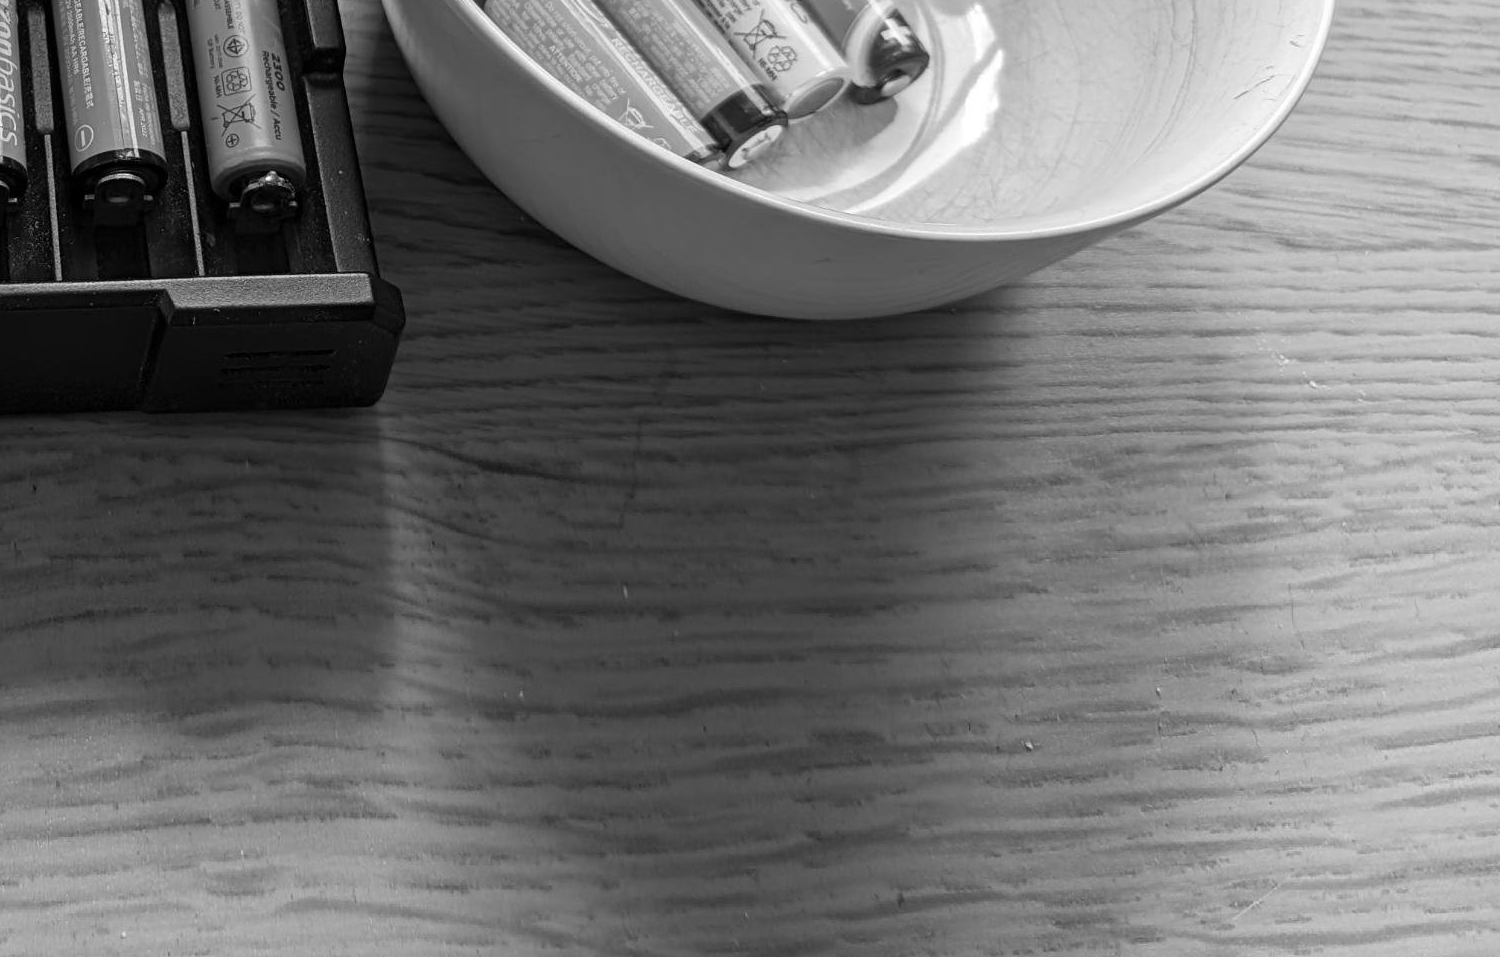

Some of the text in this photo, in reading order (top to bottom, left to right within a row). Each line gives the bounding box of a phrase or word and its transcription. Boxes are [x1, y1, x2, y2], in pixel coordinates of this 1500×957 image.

[66, 10, 76, 44] 2000mAh
[545, 1, 555, 11] Do
[589, 54, 600, 66] put
[608, 76, 619, 87] fire
[70, 45, 77, 57] AA
[71, 57, 79, 74] HR6
[207, 47, 216, 68] Battery
[271, 52, 284, 91] 2300
[585, 62, 600, 78] other
[598, 79, 618, 101] battery
[610, 35, 698, 137] RECHARGEABLE
[260, 50, 278, 110] Rechargeable
[271, 117, 282, 140] Accu
[137, 106, 145, 121] APR
